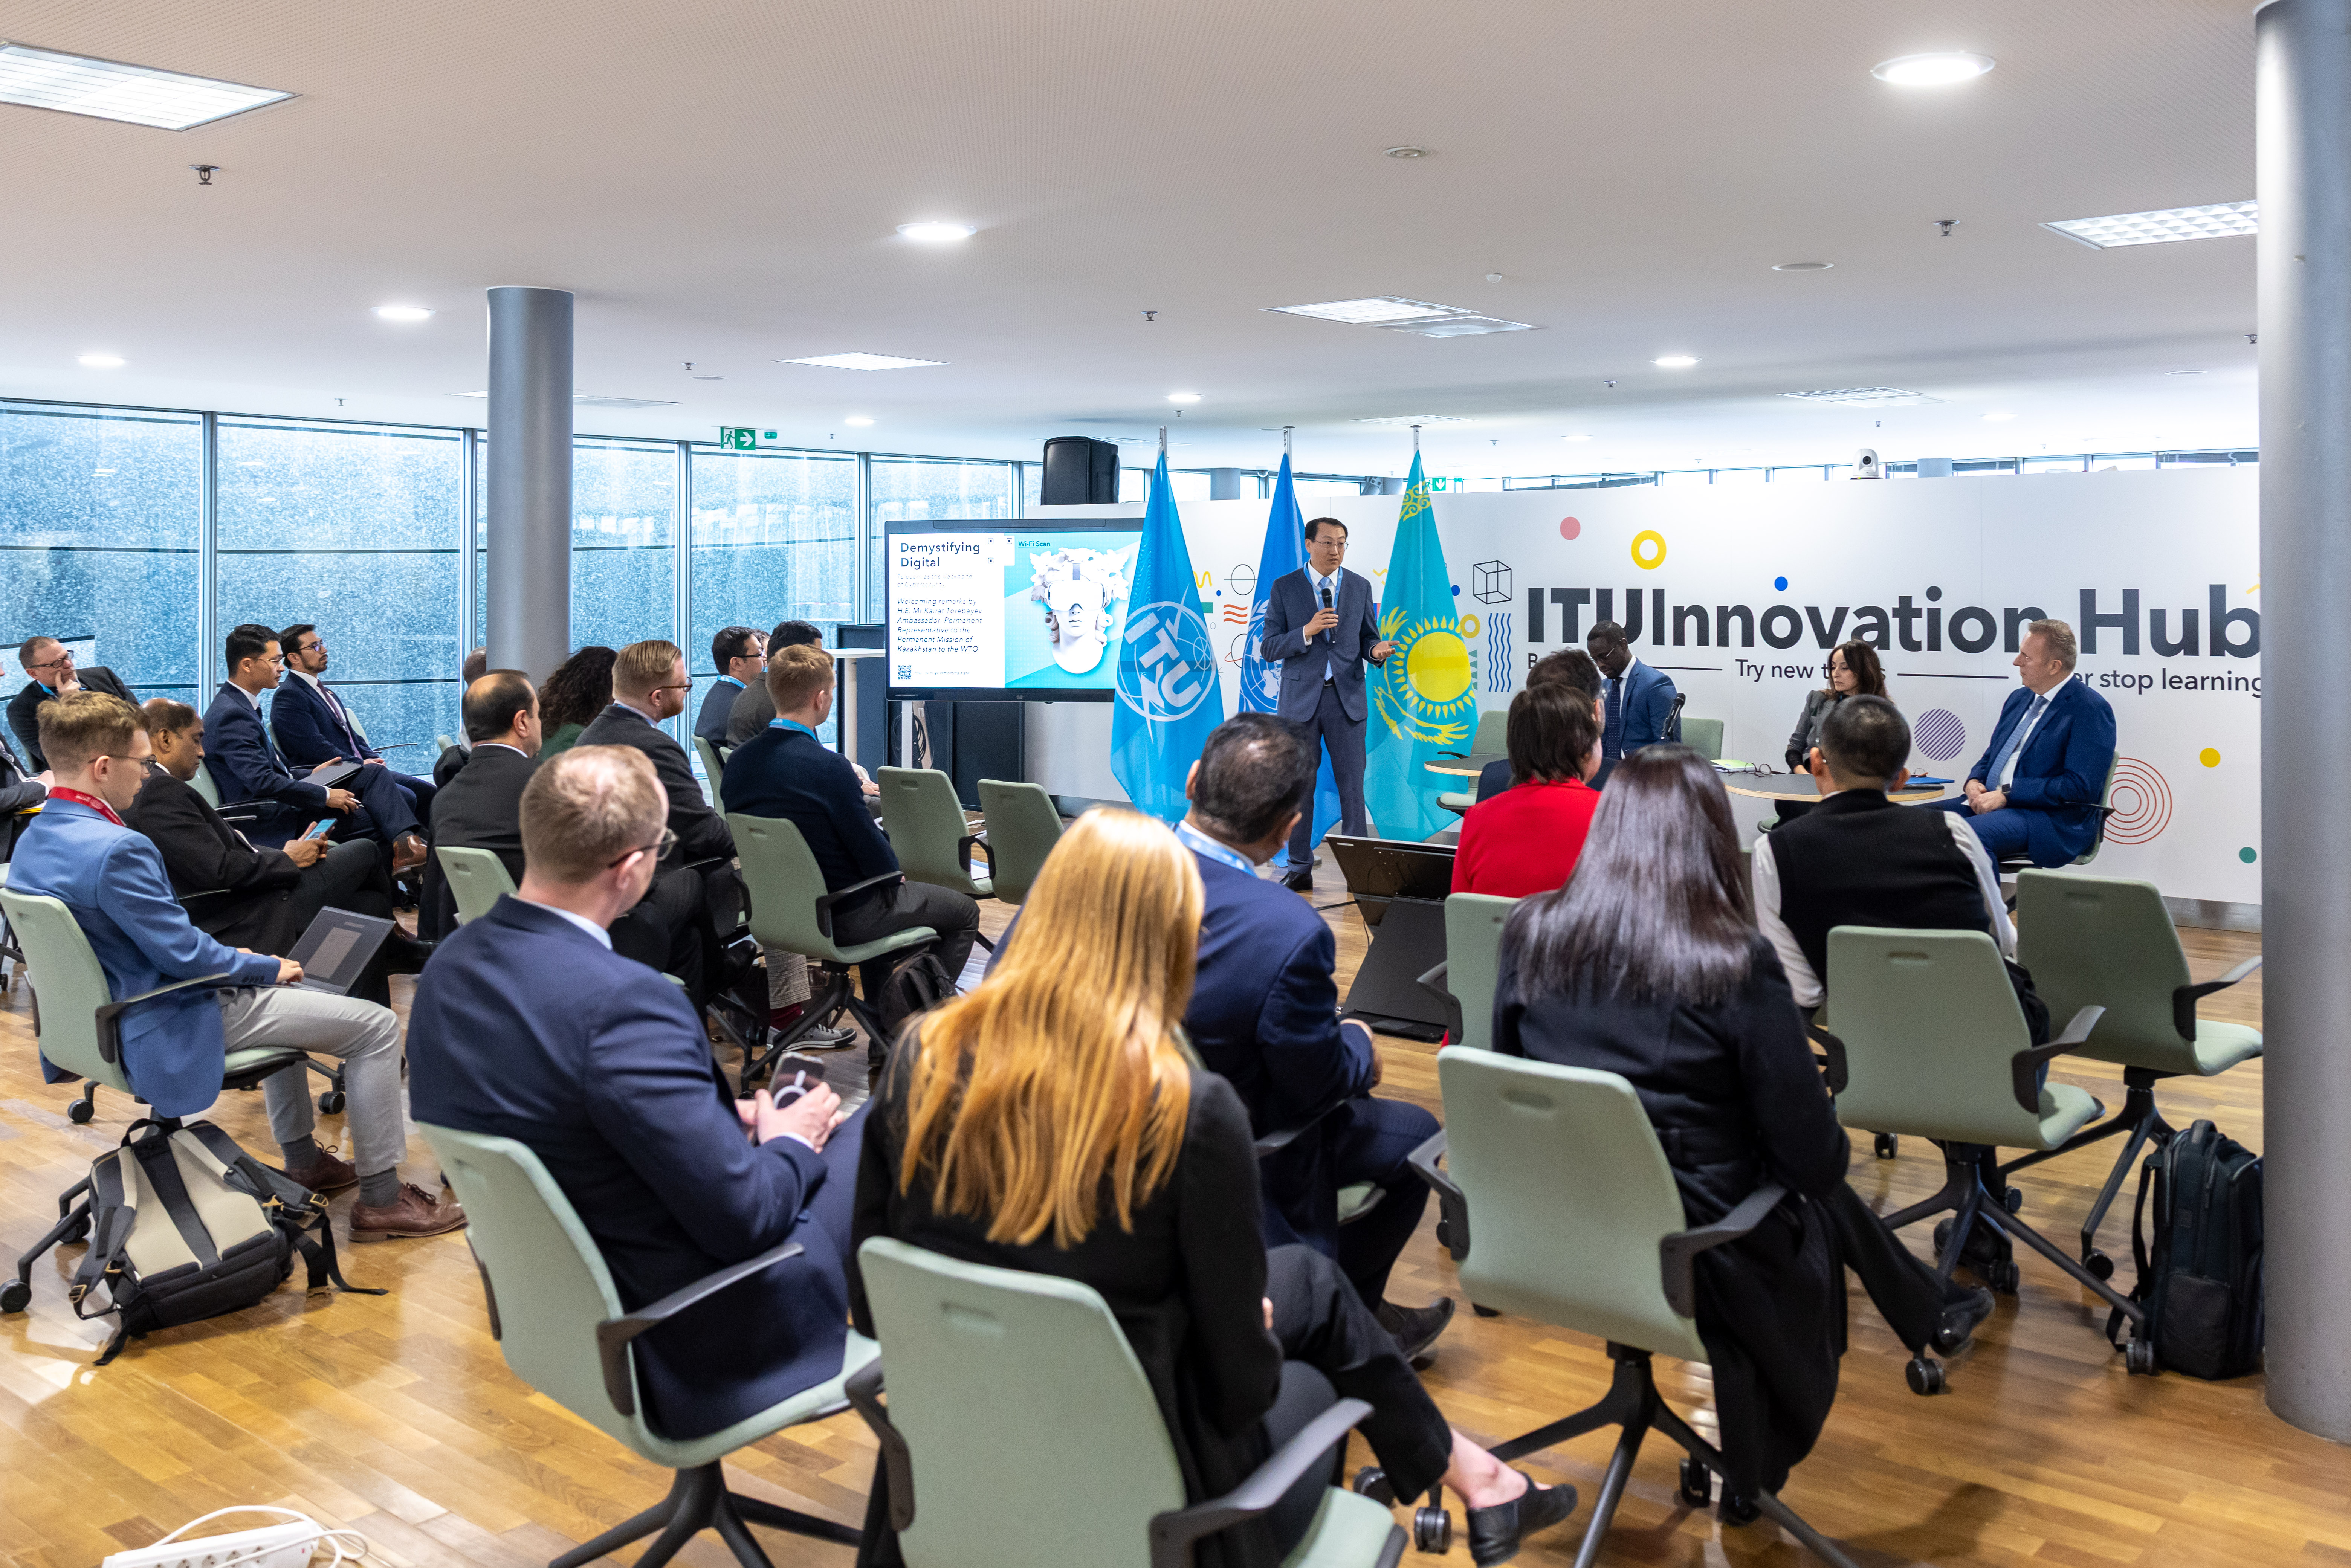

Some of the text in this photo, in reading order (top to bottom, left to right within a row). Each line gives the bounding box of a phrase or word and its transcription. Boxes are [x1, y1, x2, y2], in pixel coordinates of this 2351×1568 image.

[901, 542, 979, 555] Demystifying
[901, 557, 939, 570] Digital
[2079, 584, 2260, 658] Hub
[1124, 612, 1202, 707] ITU
[1735, 659, 1764, 682] Try
[1772, 664, 1814, 678] new
[2099, 670, 2154, 695] stop
